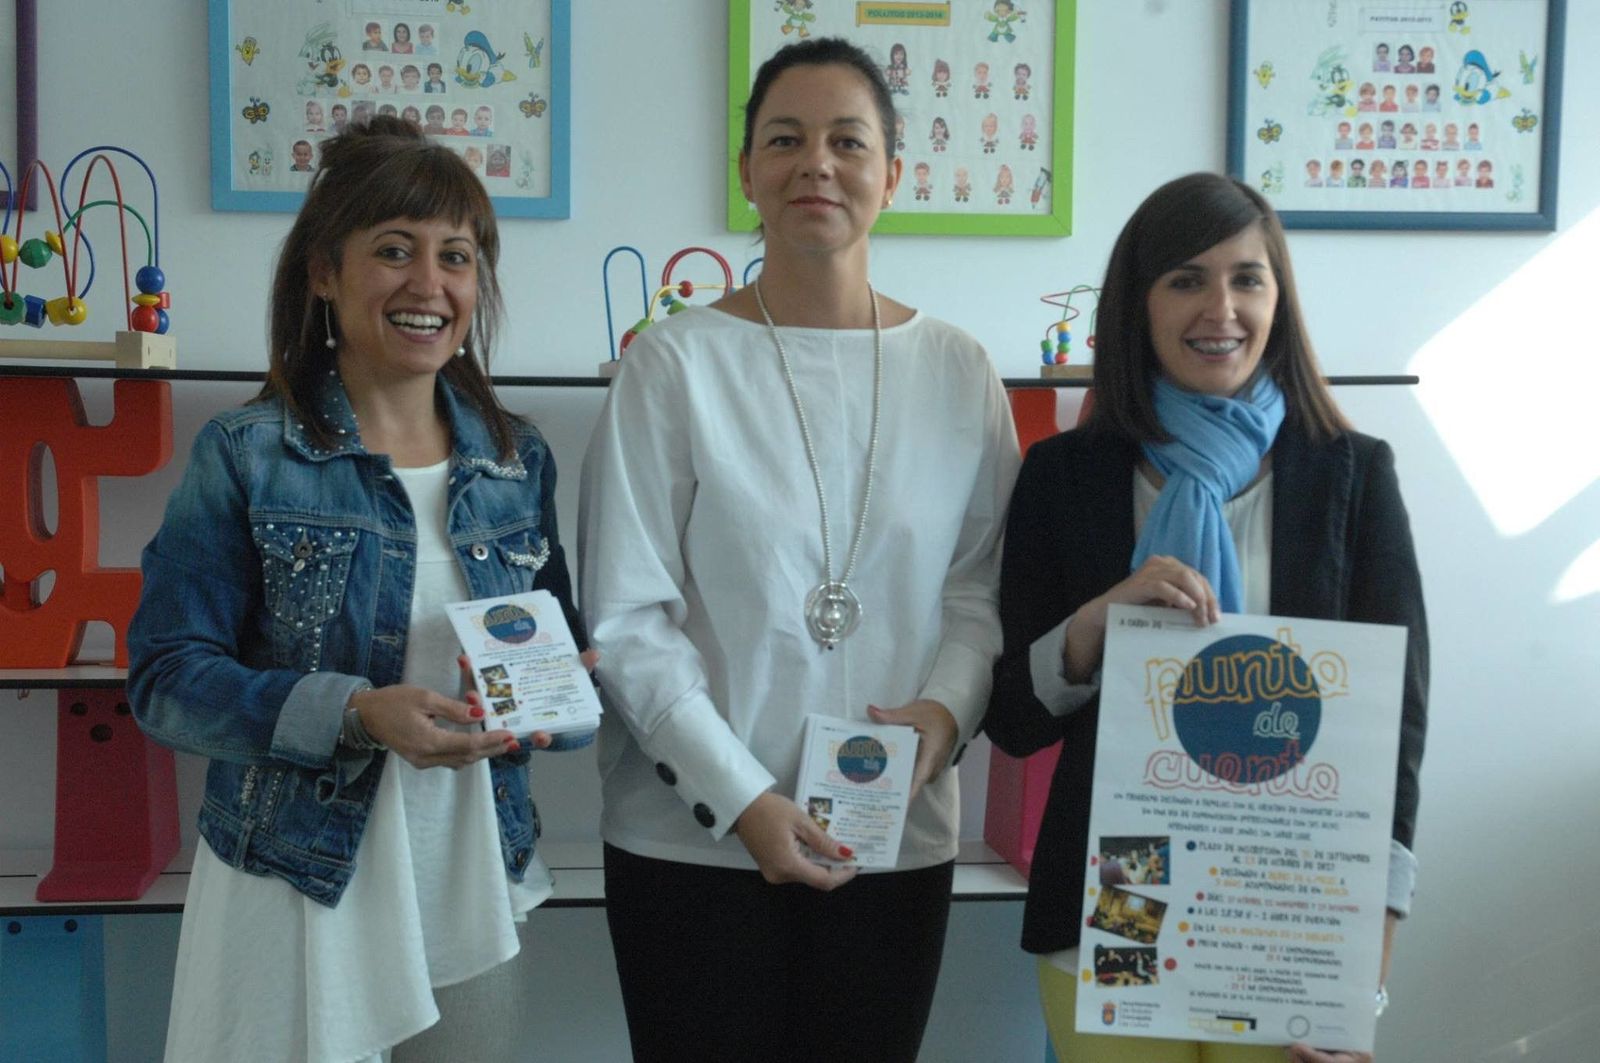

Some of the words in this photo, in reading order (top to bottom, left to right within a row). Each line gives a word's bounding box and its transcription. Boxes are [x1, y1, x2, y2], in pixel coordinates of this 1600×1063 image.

[1145, 627, 1349, 740] punto
[1253, 702, 1300, 740] de
[1143, 738, 1339, 800] cuento
